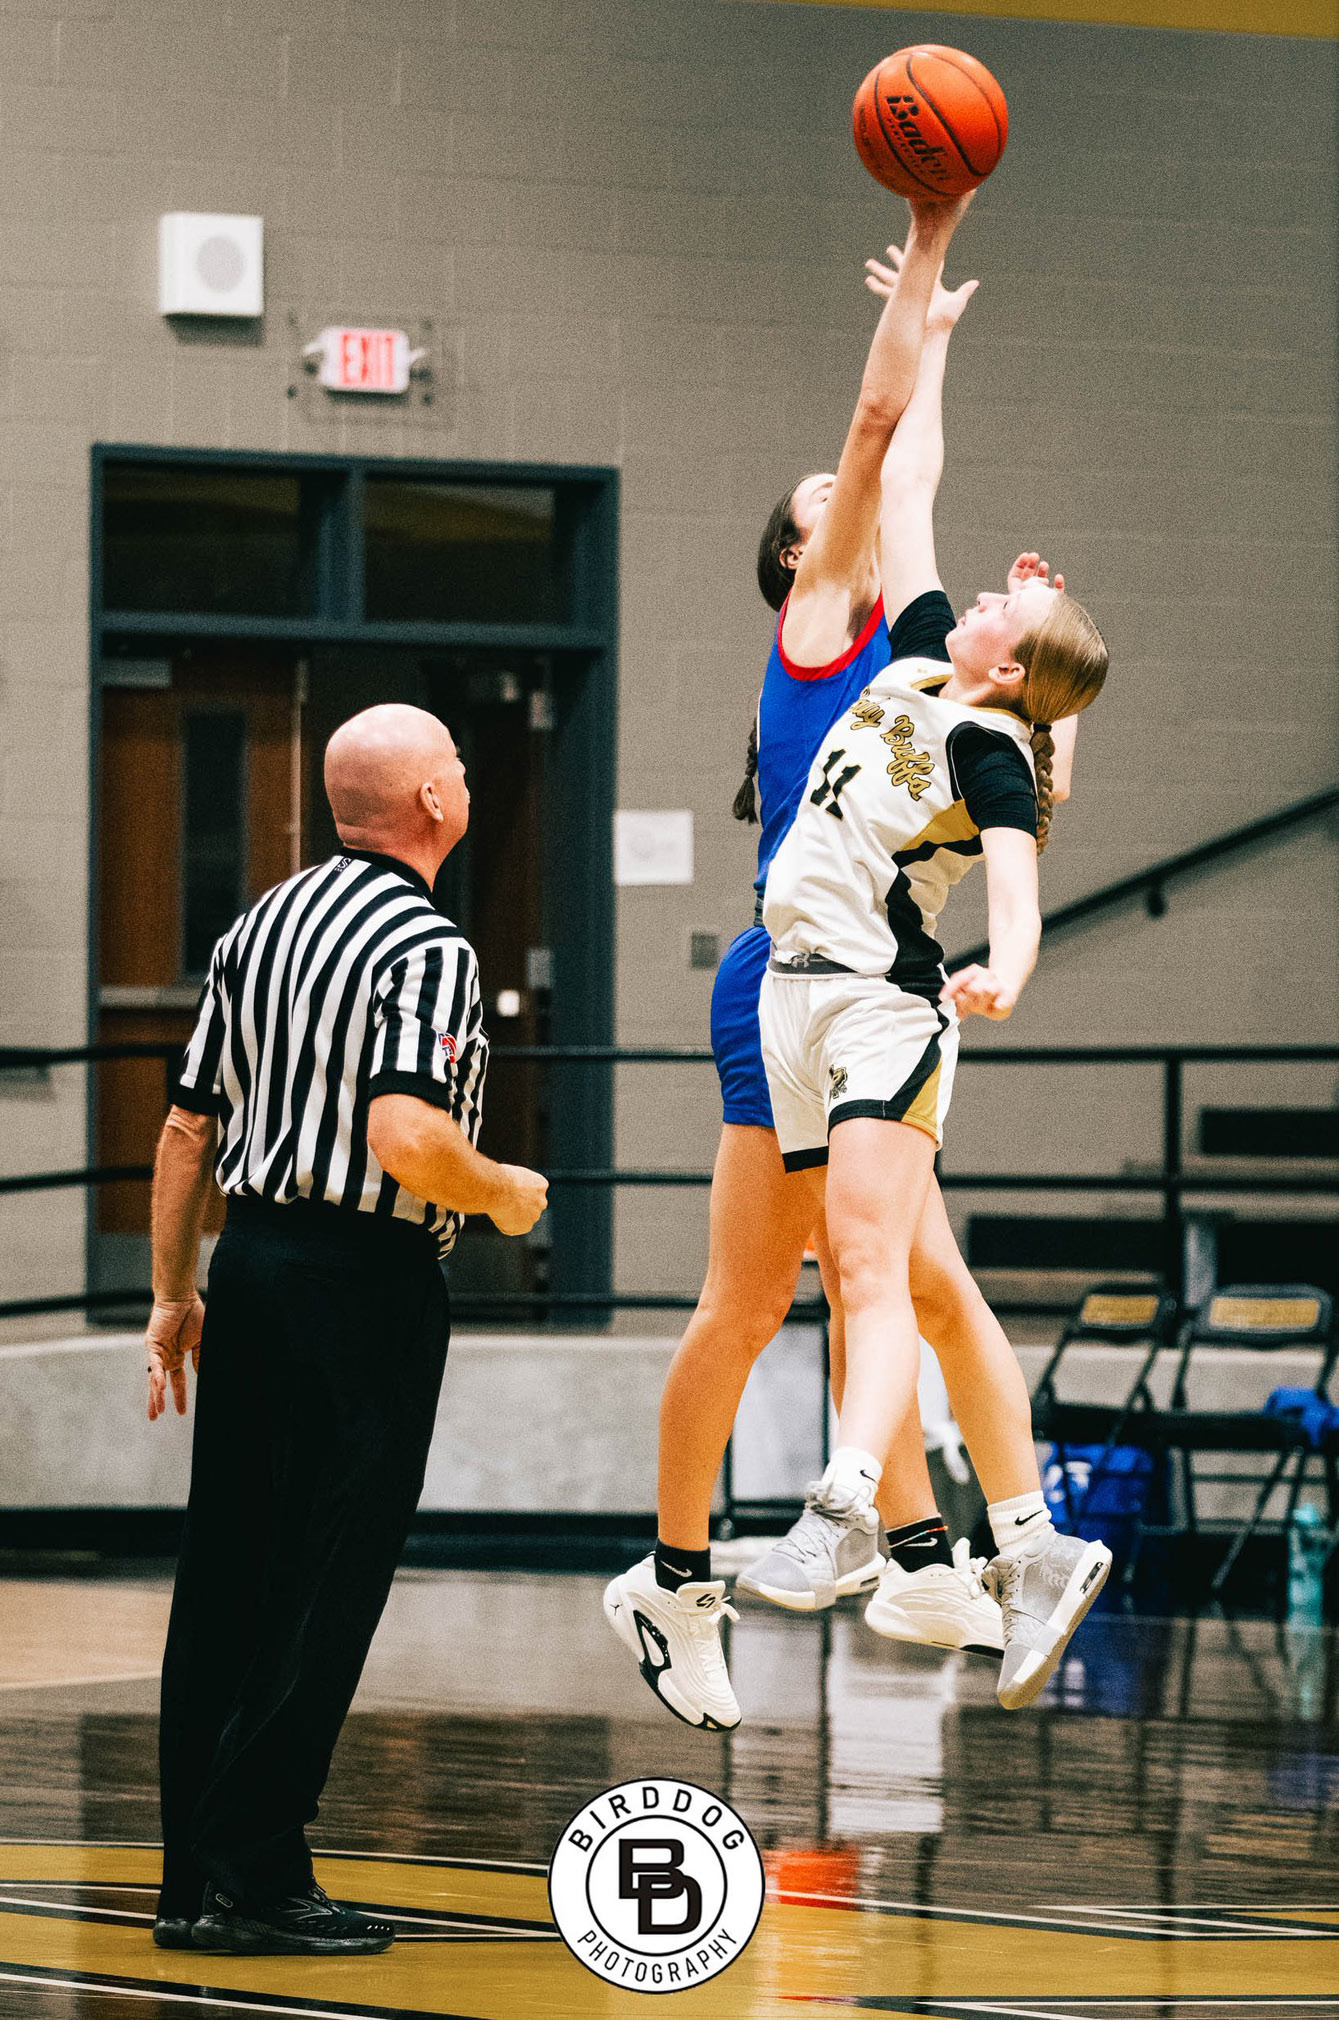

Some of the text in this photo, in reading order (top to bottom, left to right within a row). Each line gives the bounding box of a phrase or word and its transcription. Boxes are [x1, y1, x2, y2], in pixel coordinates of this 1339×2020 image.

[339, 332, 395, 387] EXIT
[809, 748, 862, 821] 11
[880, 714, 936, 802] Buffs
